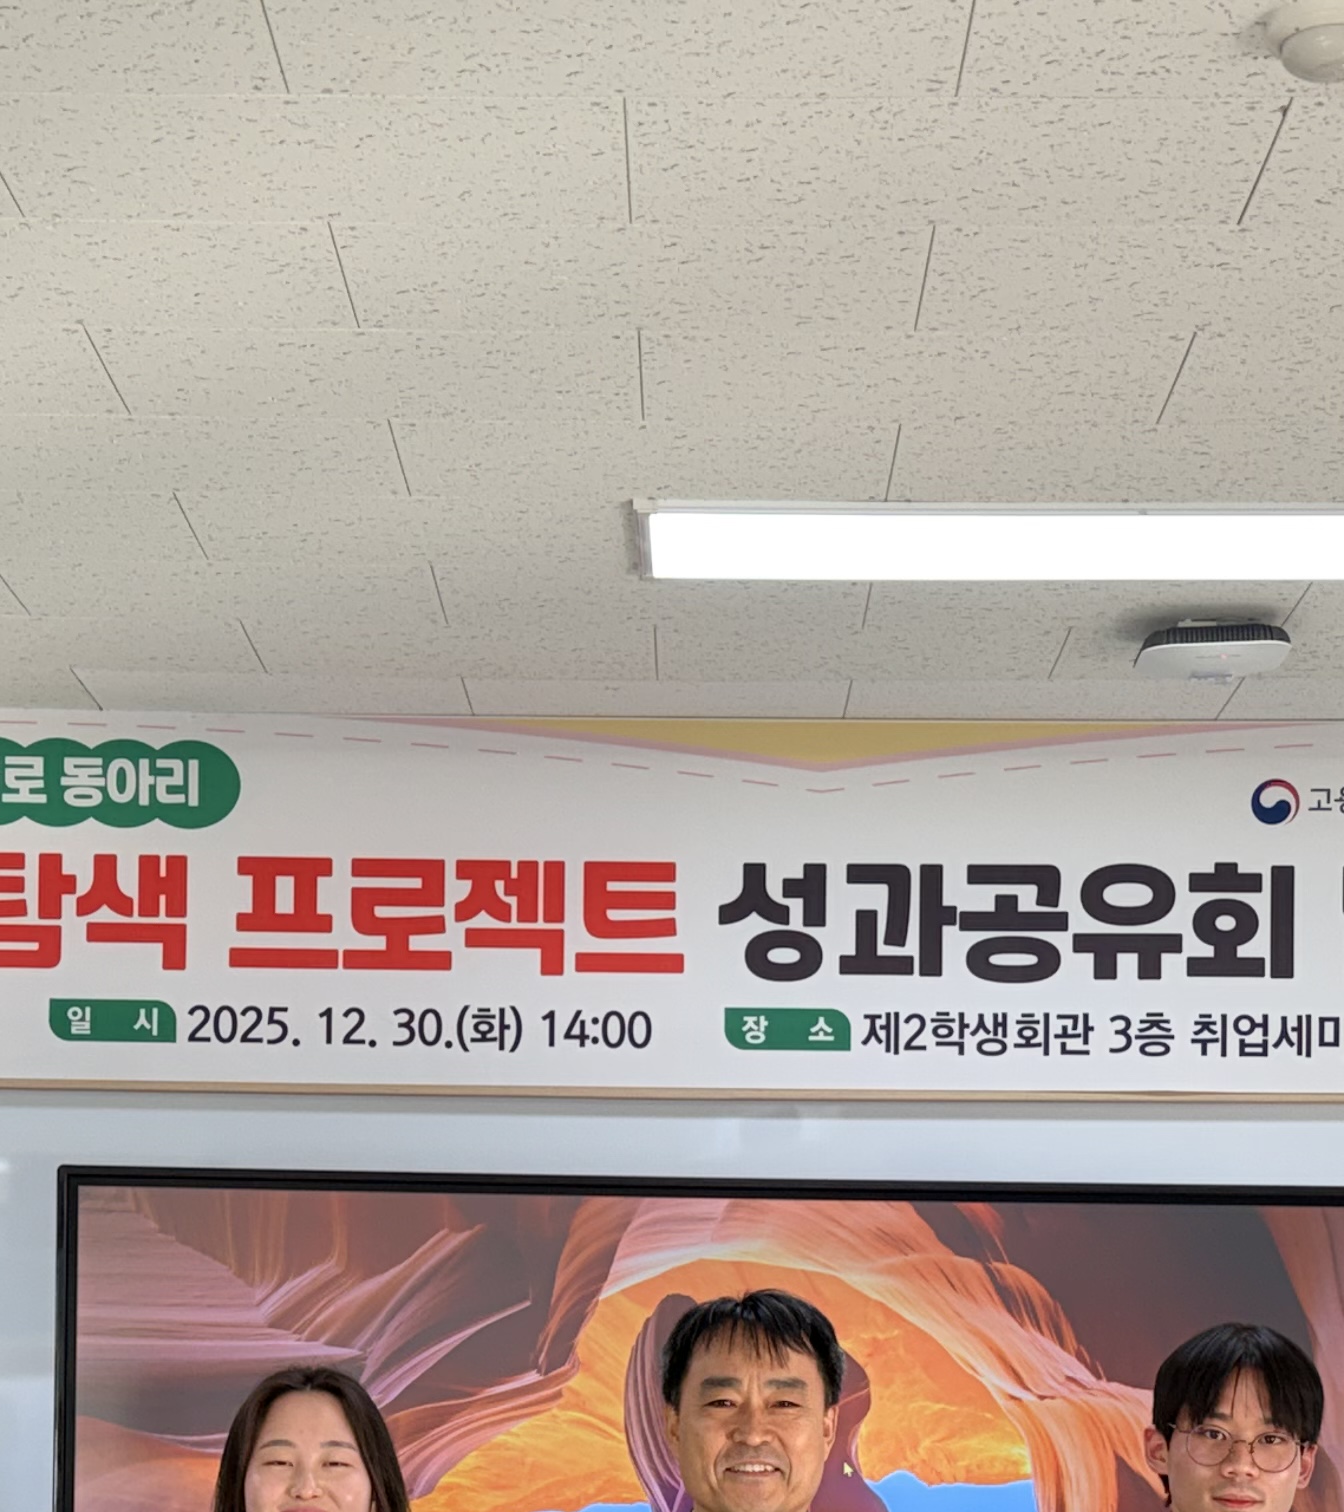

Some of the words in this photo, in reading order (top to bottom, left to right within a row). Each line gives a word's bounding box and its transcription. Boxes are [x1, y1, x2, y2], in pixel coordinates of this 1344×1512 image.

[60, 756, 200, 807] 동아리
[228, 855, 685, 977] 프로젝트
[718, 861, 1295, 984] 성과공유회
[186, 1004, 303, 1048] 2025.
[317, 1006, 378, 1049] 12.
[391, 1005, 523, 1053] 30.(화)
[541, 1009, 653, 1050] 14:00
[861, 1011, 1094, 1057] 제2학생회관
[1108, 1013, 1176, 1058] 3층
